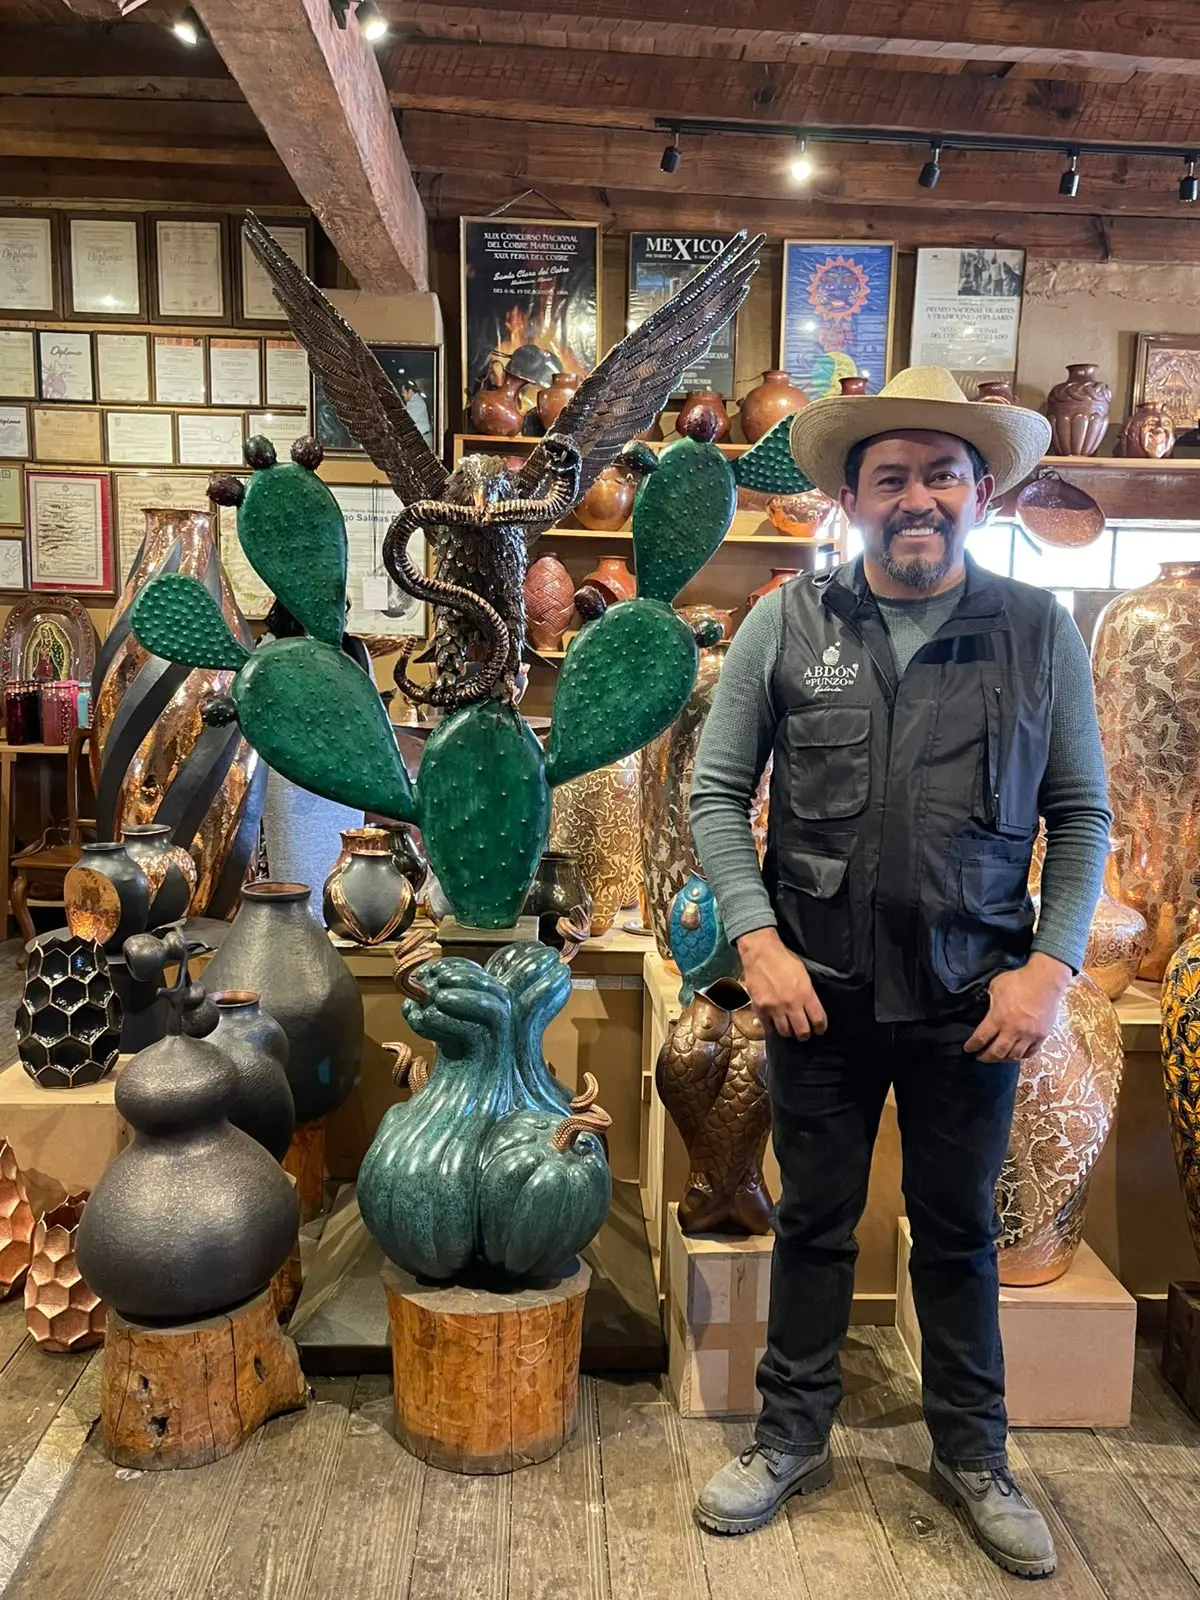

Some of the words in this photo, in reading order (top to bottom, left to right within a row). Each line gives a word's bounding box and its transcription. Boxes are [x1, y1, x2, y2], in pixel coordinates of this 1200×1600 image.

[484, 232, 500, 240] XLIX
[500, 232, 541, 241] CONCURSO
[542, 234, 578, 242] NACIONAL
[503, 241, 528, 249] COBRE
[530, 242, 576, 251] MARTILLADO
[493, 272, 515, 280] Santa
[516, 269, 536, 278] Clara
[537, 267, 550, 276] del
[550, 265, 570, 274] Cobre
[356, 513, 389, 523] Salinas
[803, 664, 857, 679] ABDÓN
[810, 678, 848, 686] PUNZO
